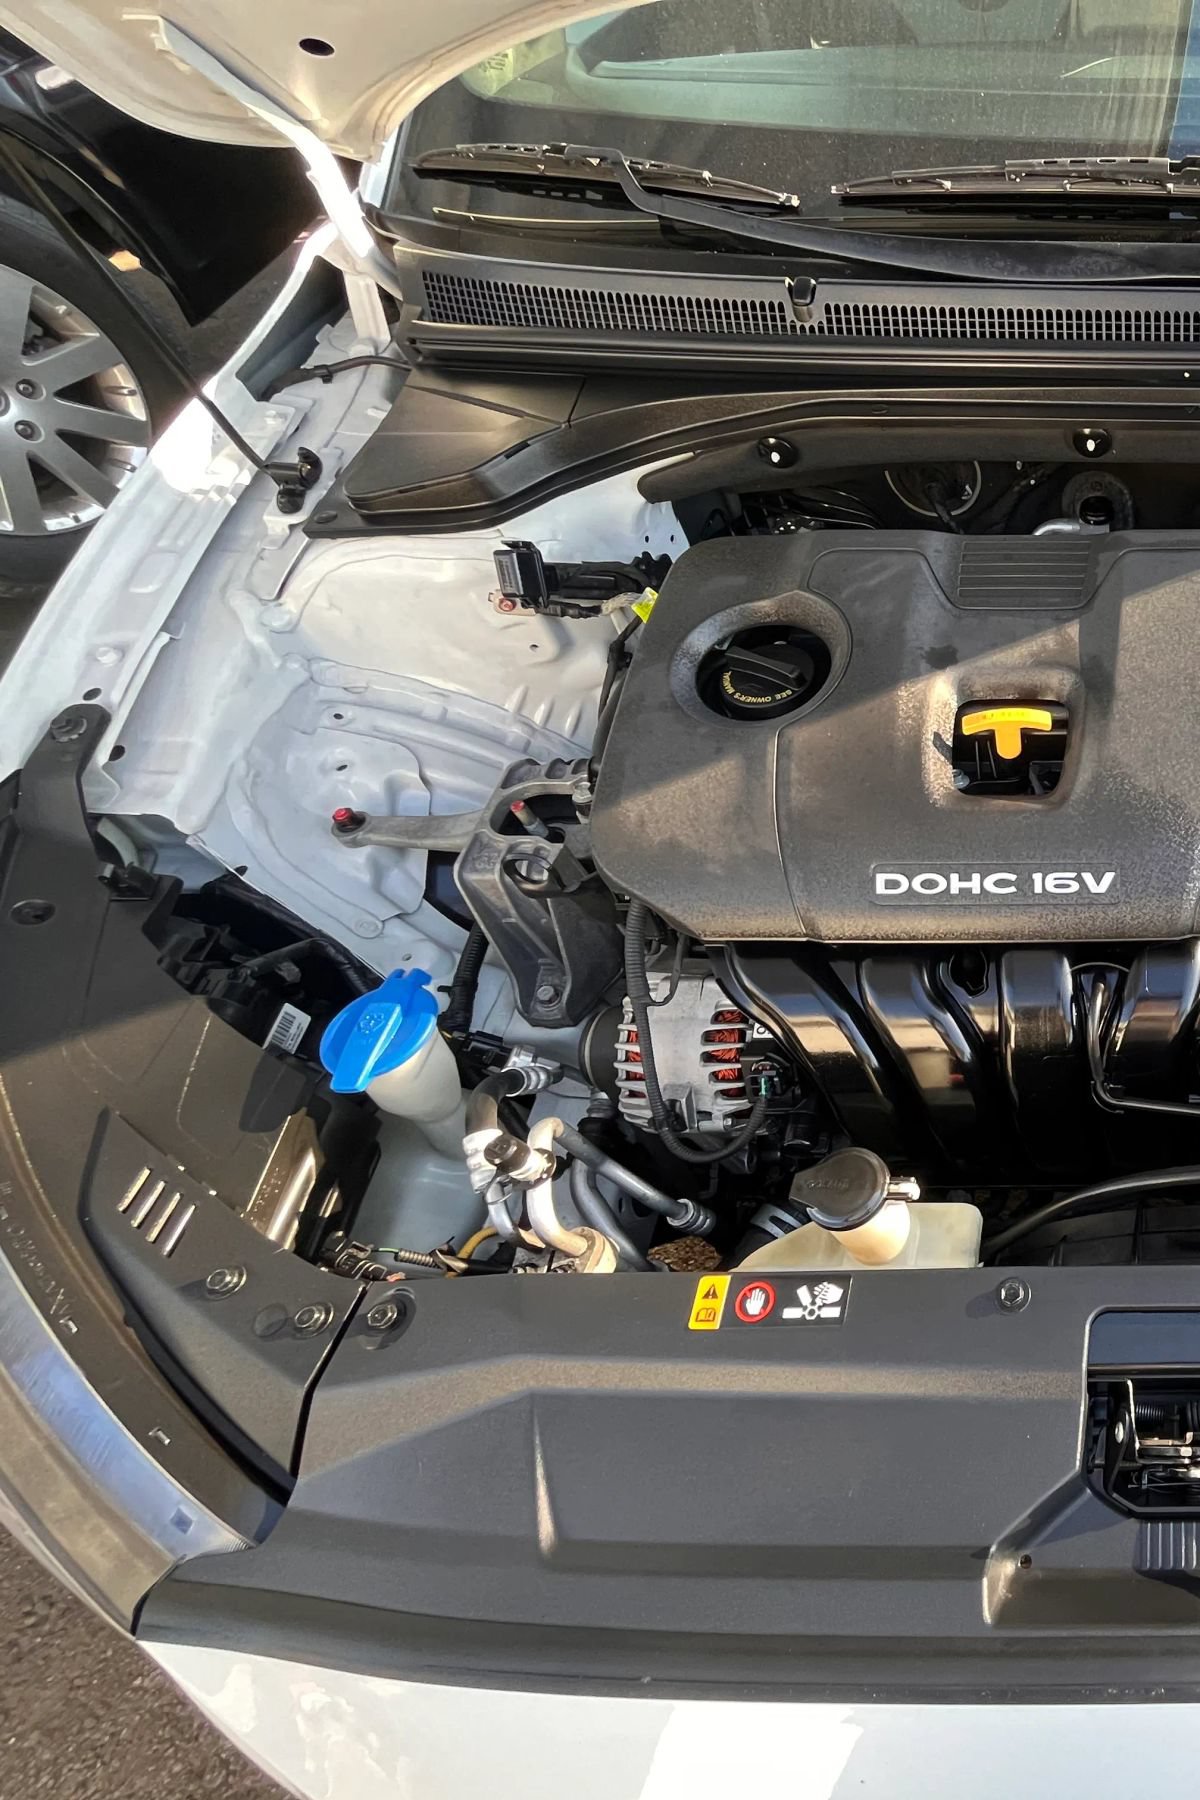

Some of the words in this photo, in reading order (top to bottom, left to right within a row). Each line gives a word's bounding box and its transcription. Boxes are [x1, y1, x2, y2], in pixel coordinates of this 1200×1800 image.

[723, 671, 735, 694] MANUAL
[734, 692, 771, 703] OWNER'S
[775, 690, 792, 700] SEE
[875, 872, 1018, 895] DOHC
[1031, 871, 1116, 894] 16V
